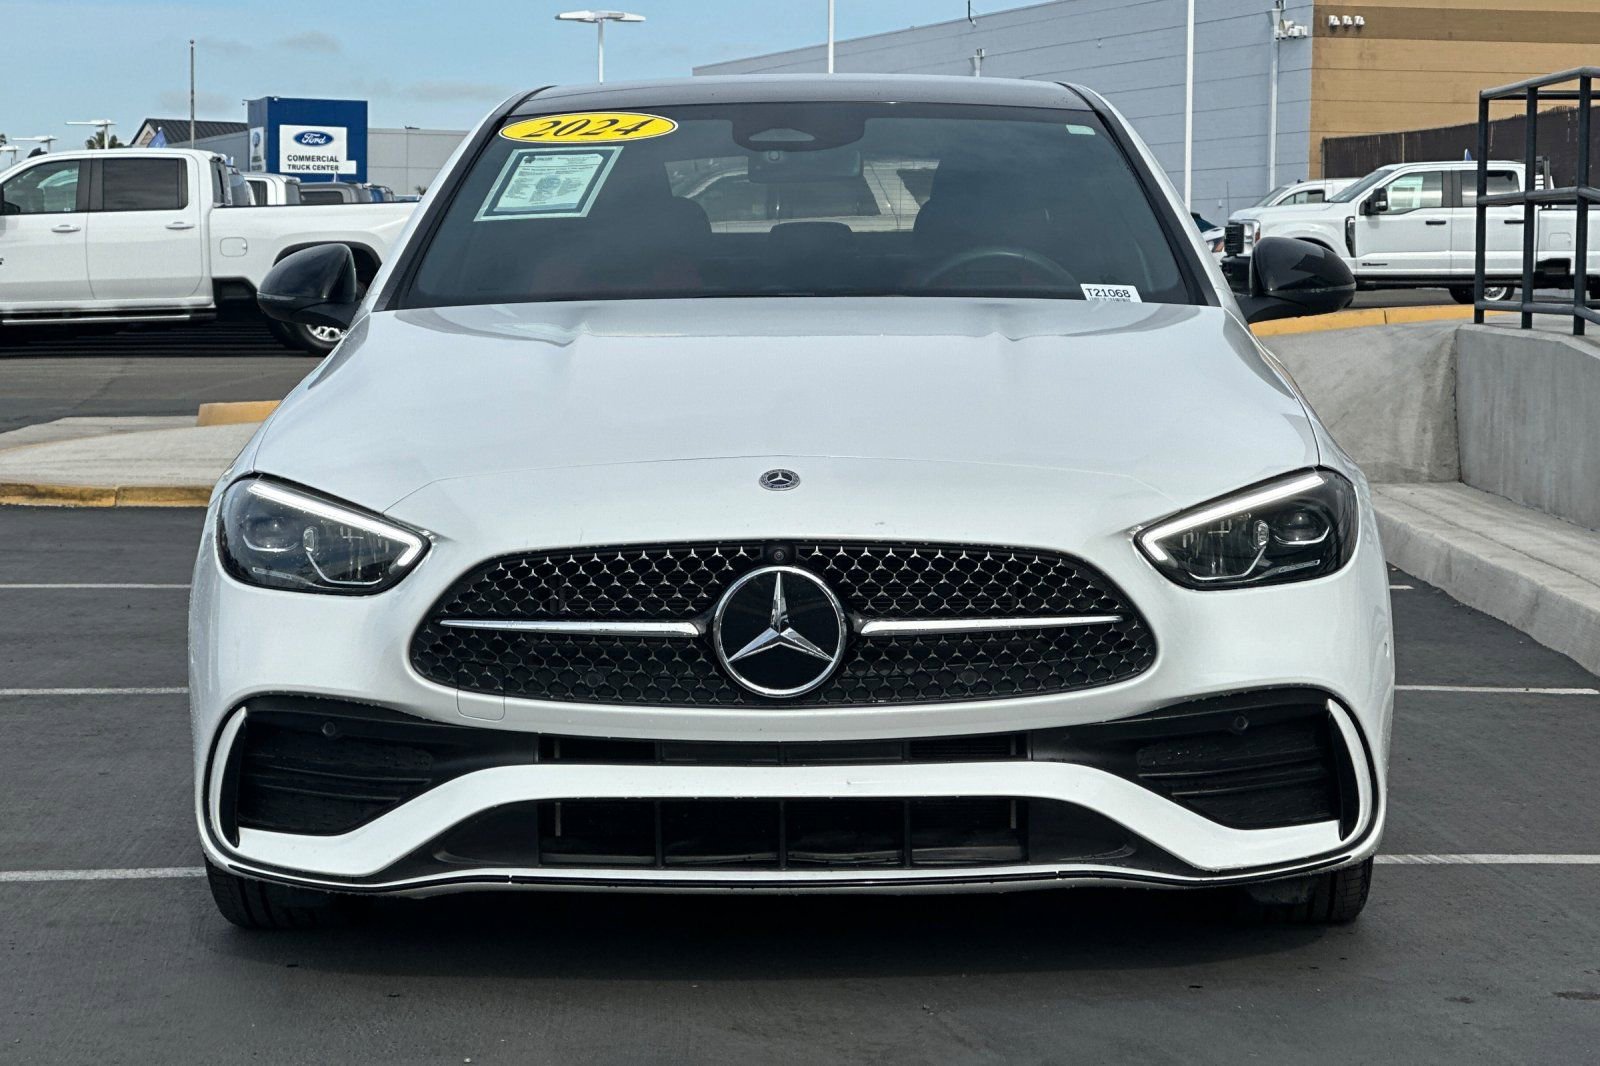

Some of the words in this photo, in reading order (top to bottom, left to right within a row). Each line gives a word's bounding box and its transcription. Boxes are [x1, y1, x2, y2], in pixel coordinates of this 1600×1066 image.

[522, 118, 656, 137] 2024
[301, 132, 327, 144] Ford
[287, 154, 339, 162] COMMERCIAL
[1085, 288, 1131, 298] T21068
